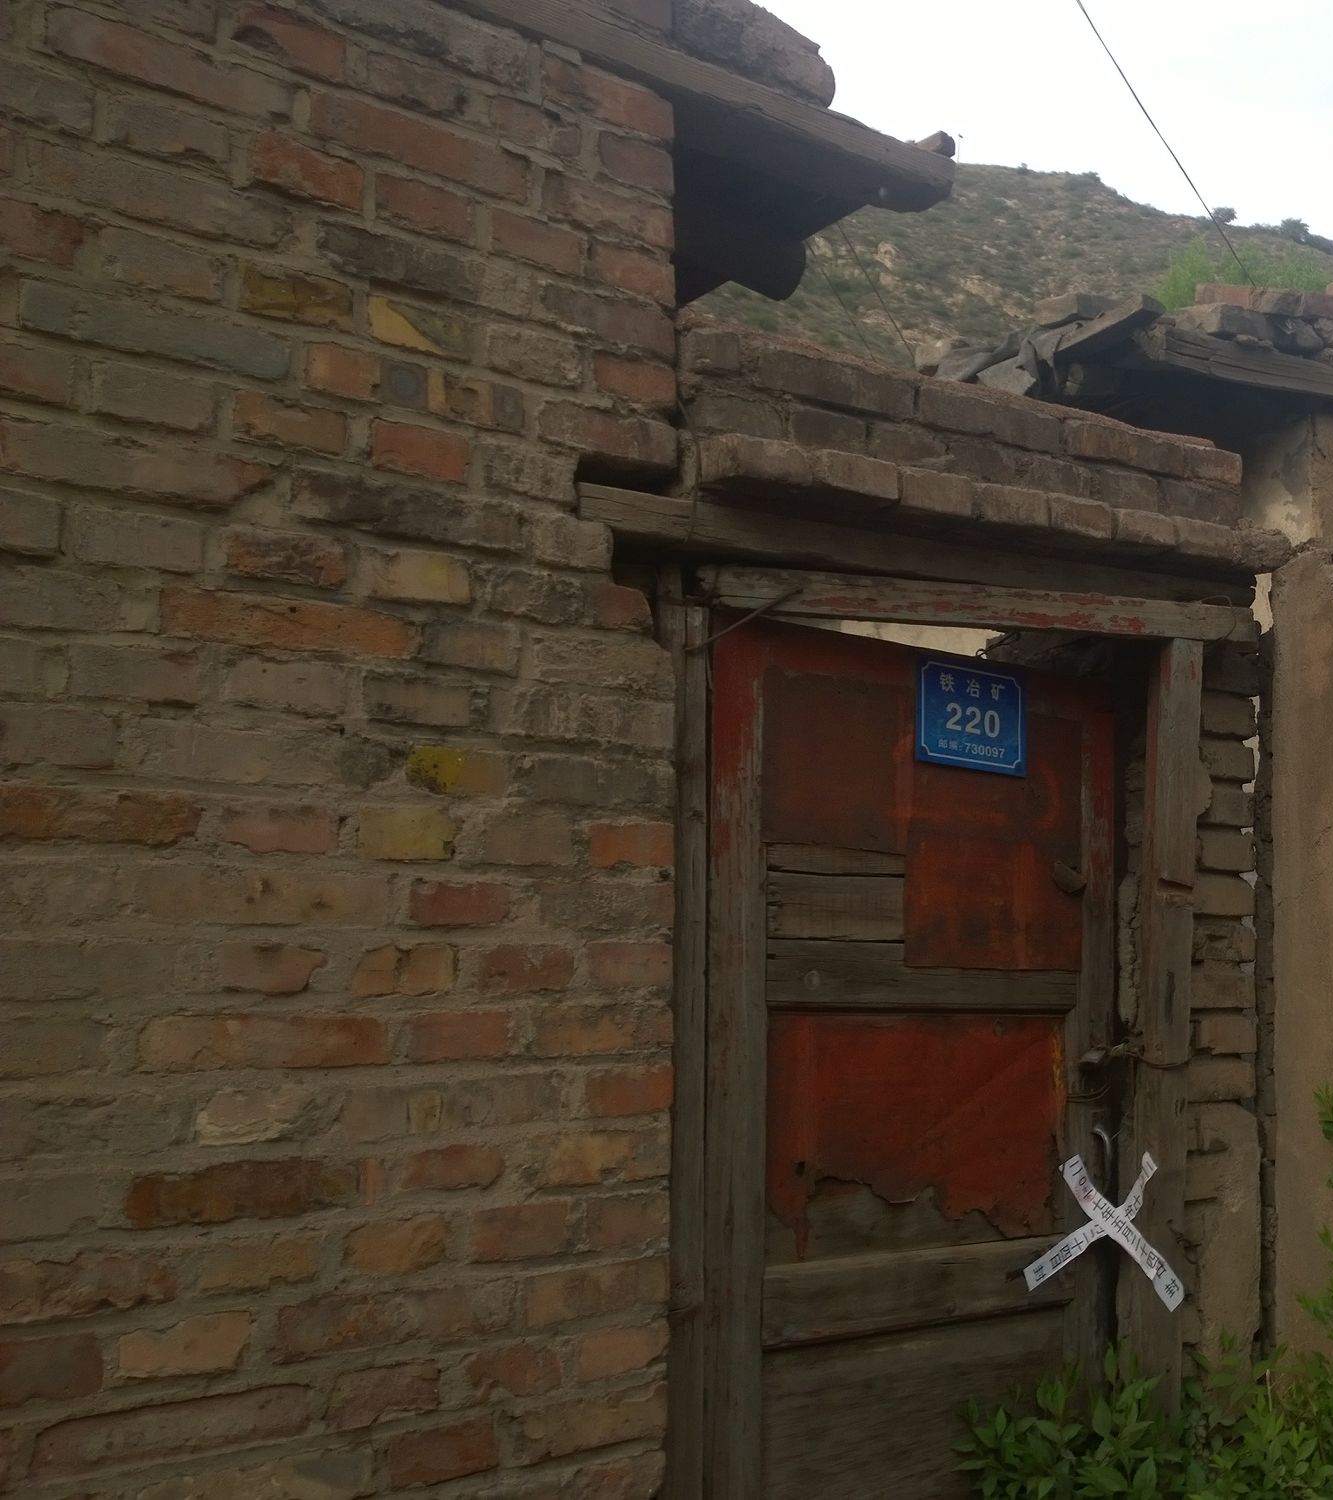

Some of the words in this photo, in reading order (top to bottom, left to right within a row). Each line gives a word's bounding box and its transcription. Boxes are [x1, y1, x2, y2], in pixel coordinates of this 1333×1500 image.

[939, 671, 1005, 701] 铁冶矿
[945, 702, 1000, 738] 220
